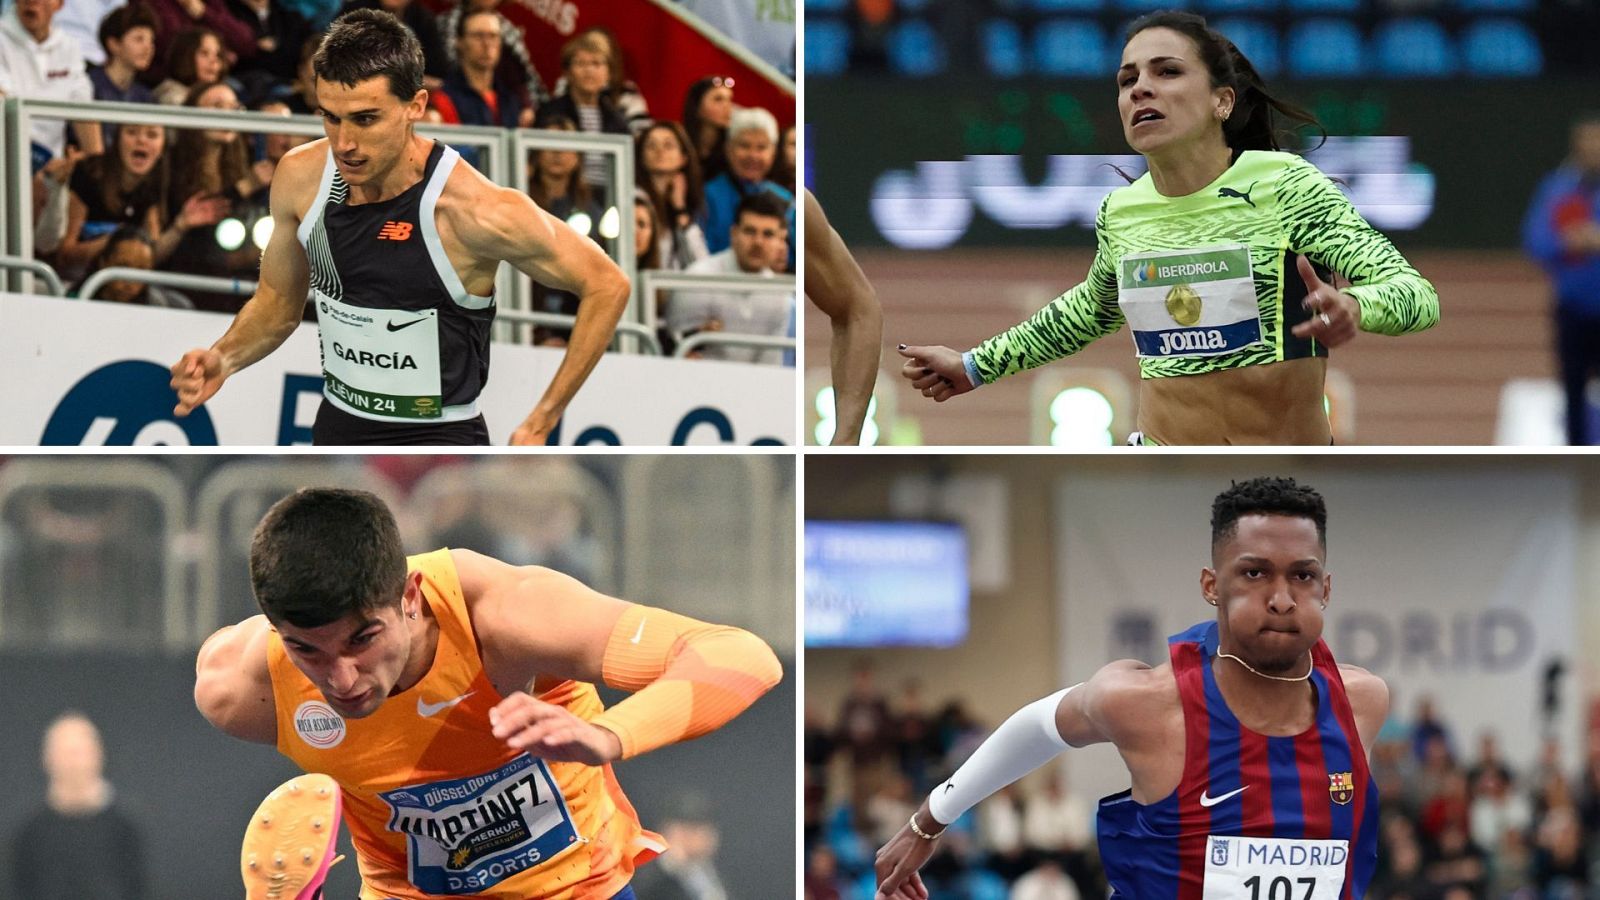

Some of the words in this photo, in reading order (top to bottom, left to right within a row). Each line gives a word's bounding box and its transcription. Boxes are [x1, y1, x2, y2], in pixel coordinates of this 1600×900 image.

[1158, 261, 1229, 279] IBERDROLA
[333, 341, 418, 370] GARCÍA
[373, 397, 397, 412] 24
[1336, 606, 1537, 674] DRID
[424, 773, 500, 807] DÜSSELDORF
[502, 757, 533, 778] 2024
[470, 820, 521, 844] MERKUR
[1247, 843, 1347, 867] MADRID
[448, 848, 541, 890] D.SPORTS
[1243, 875, 1317, 900] 107
